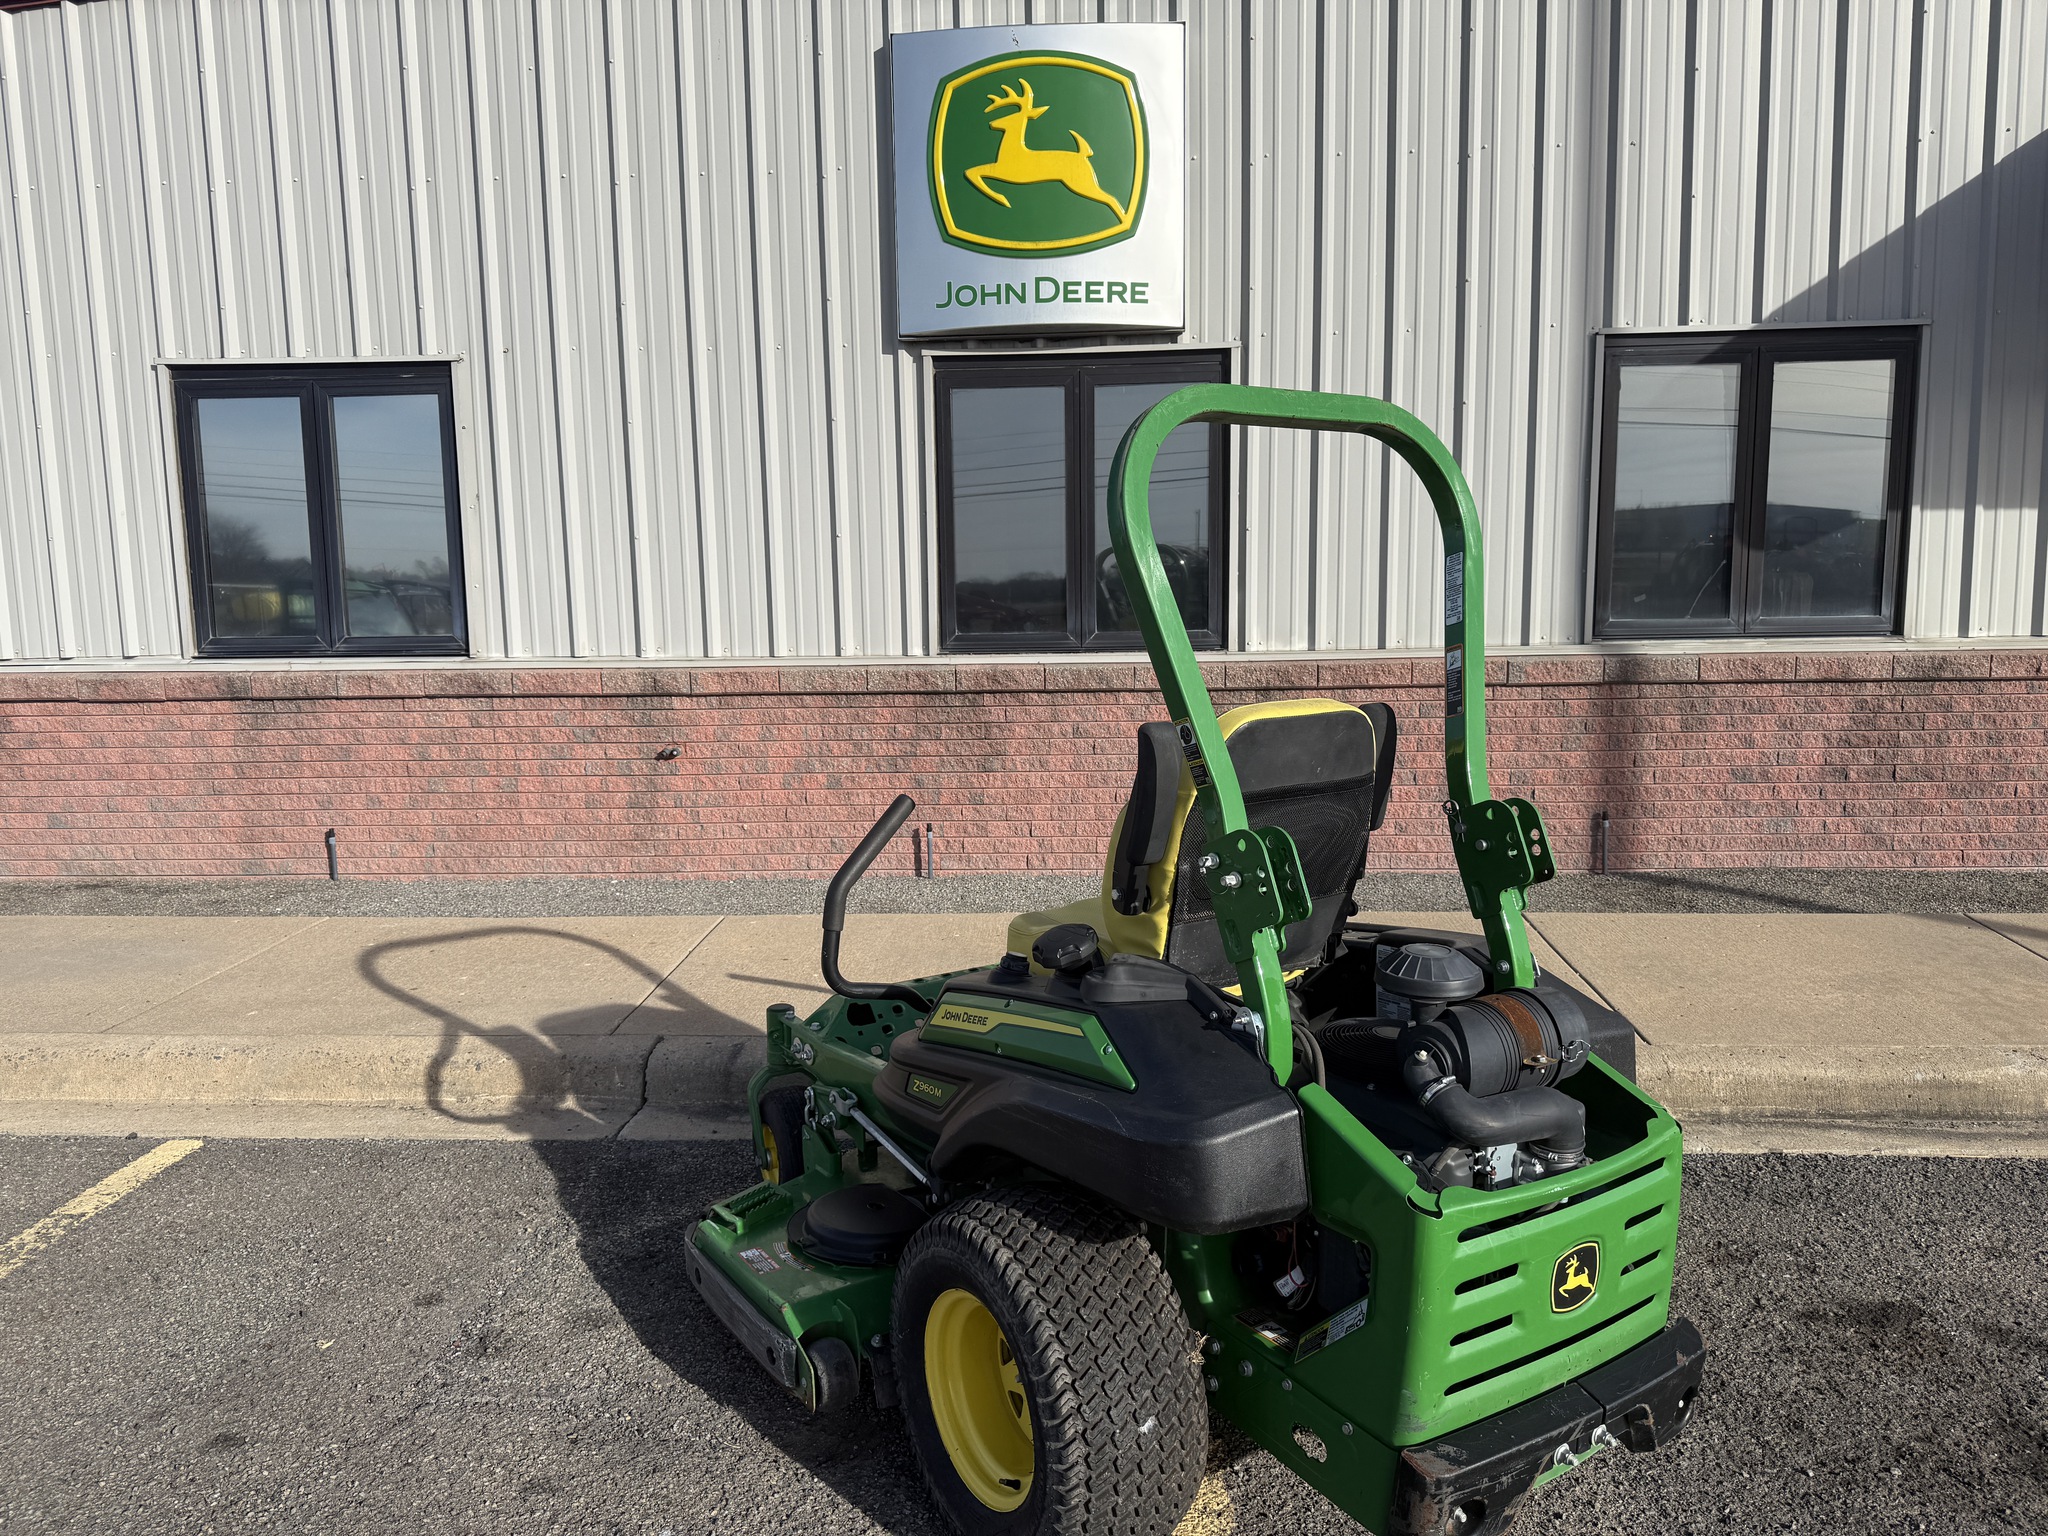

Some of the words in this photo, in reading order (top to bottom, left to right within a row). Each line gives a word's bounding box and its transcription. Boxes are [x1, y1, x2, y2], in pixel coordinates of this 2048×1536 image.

[935, 281, 1027, 309] JOHN
[1034, 276, 1149, 304] DEERE
[941, 1009, 961, 1021] JOHN
[962, 1012, 988, 1026] DEERE
[913, 1080, 942, 1097] Z960M
